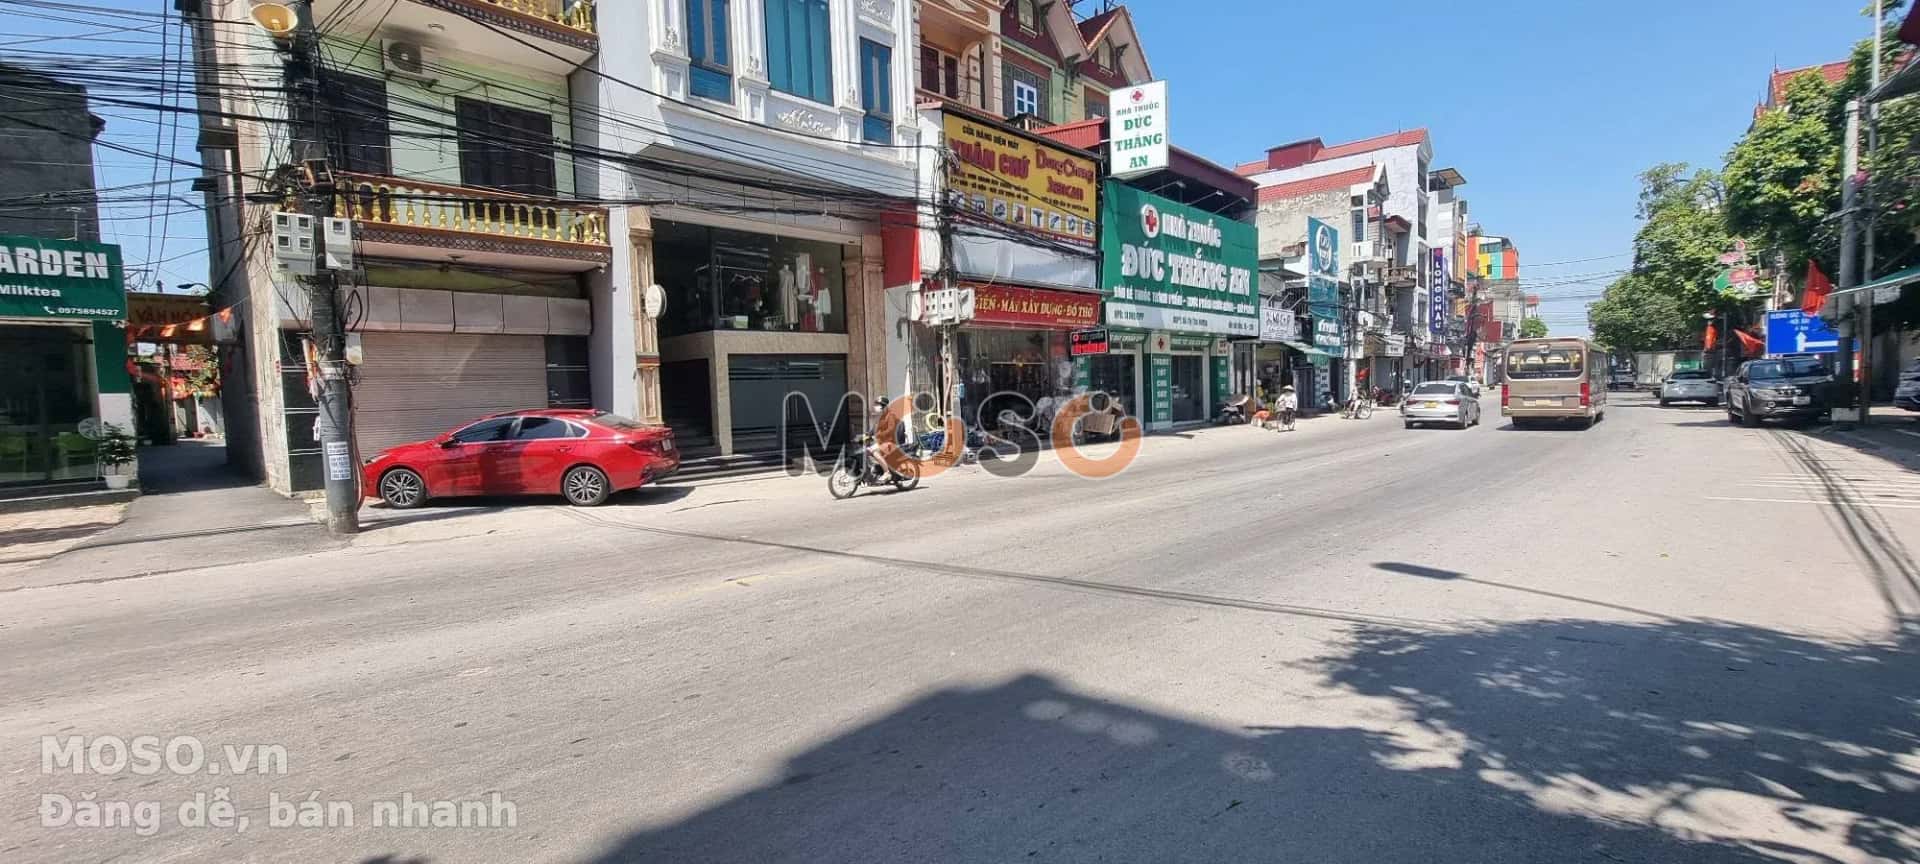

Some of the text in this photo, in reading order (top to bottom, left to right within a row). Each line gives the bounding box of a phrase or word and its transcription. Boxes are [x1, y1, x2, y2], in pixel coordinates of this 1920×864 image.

[1129, 155, 1148, 168] AN
[1121, 240, 1165, 282] ĐỨC
[1168, 247, 1227, 292] THẮNG
[1229, 266, 1251, 296] AN
[0, 284, 62, 297] Milktea
